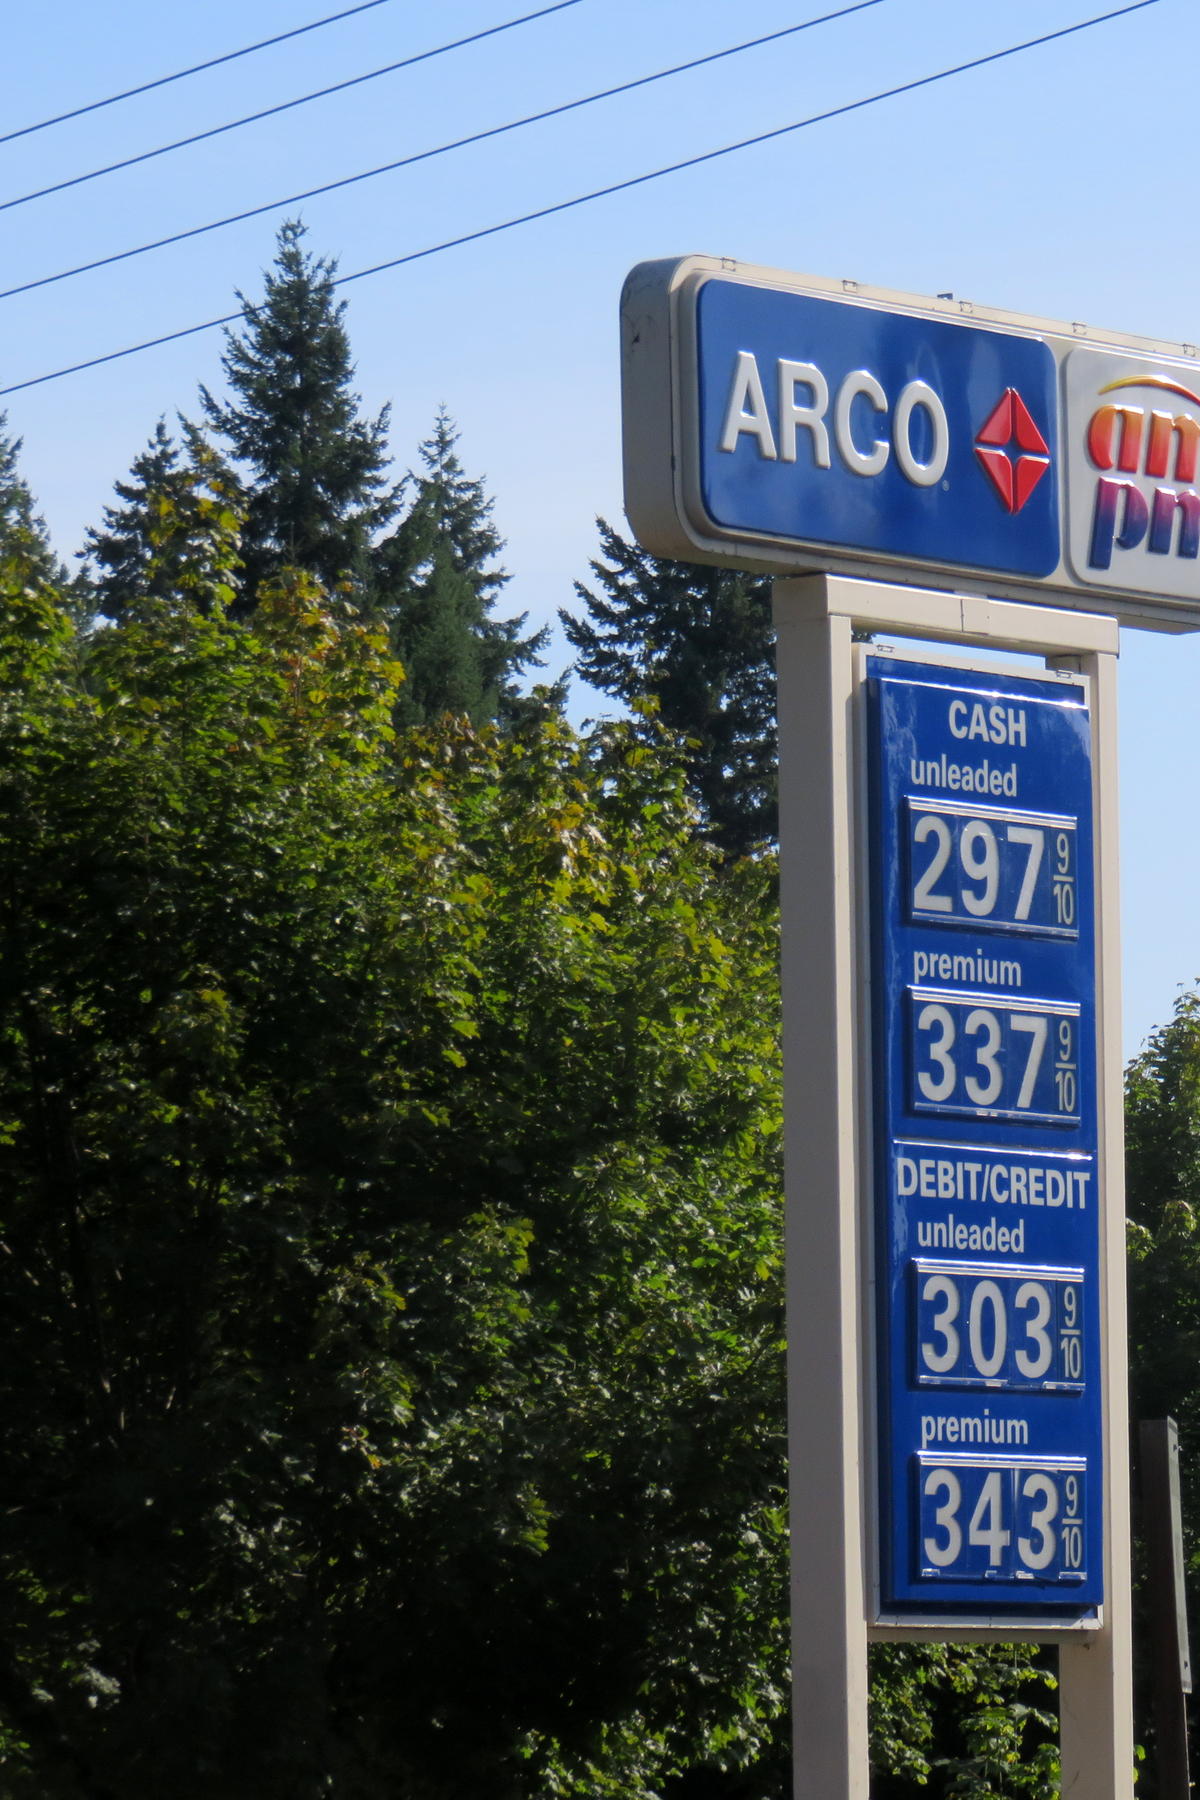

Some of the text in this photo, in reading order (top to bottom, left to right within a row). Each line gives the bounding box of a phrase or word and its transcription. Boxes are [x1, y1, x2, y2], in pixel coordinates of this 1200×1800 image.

[717, 350, 949, 488] ARCO
[949, 699, 1027, 748] CASH
[911, 753, 1018, 797] unleaded
[913, 815, 1045, 921] 297
[913, 948, 1022, 986] premium
[918, 1004, 1048, 1109] 337
[896, 1157, 1091, 1210] DEBIT/CREDIT
[917, 1214, 1025, 1253] unleaded
[921, 1275, 1053, 1379] 303
[921, 1409, 1029, 1449] premium
[924, 1468, 1060, 1571] 343
